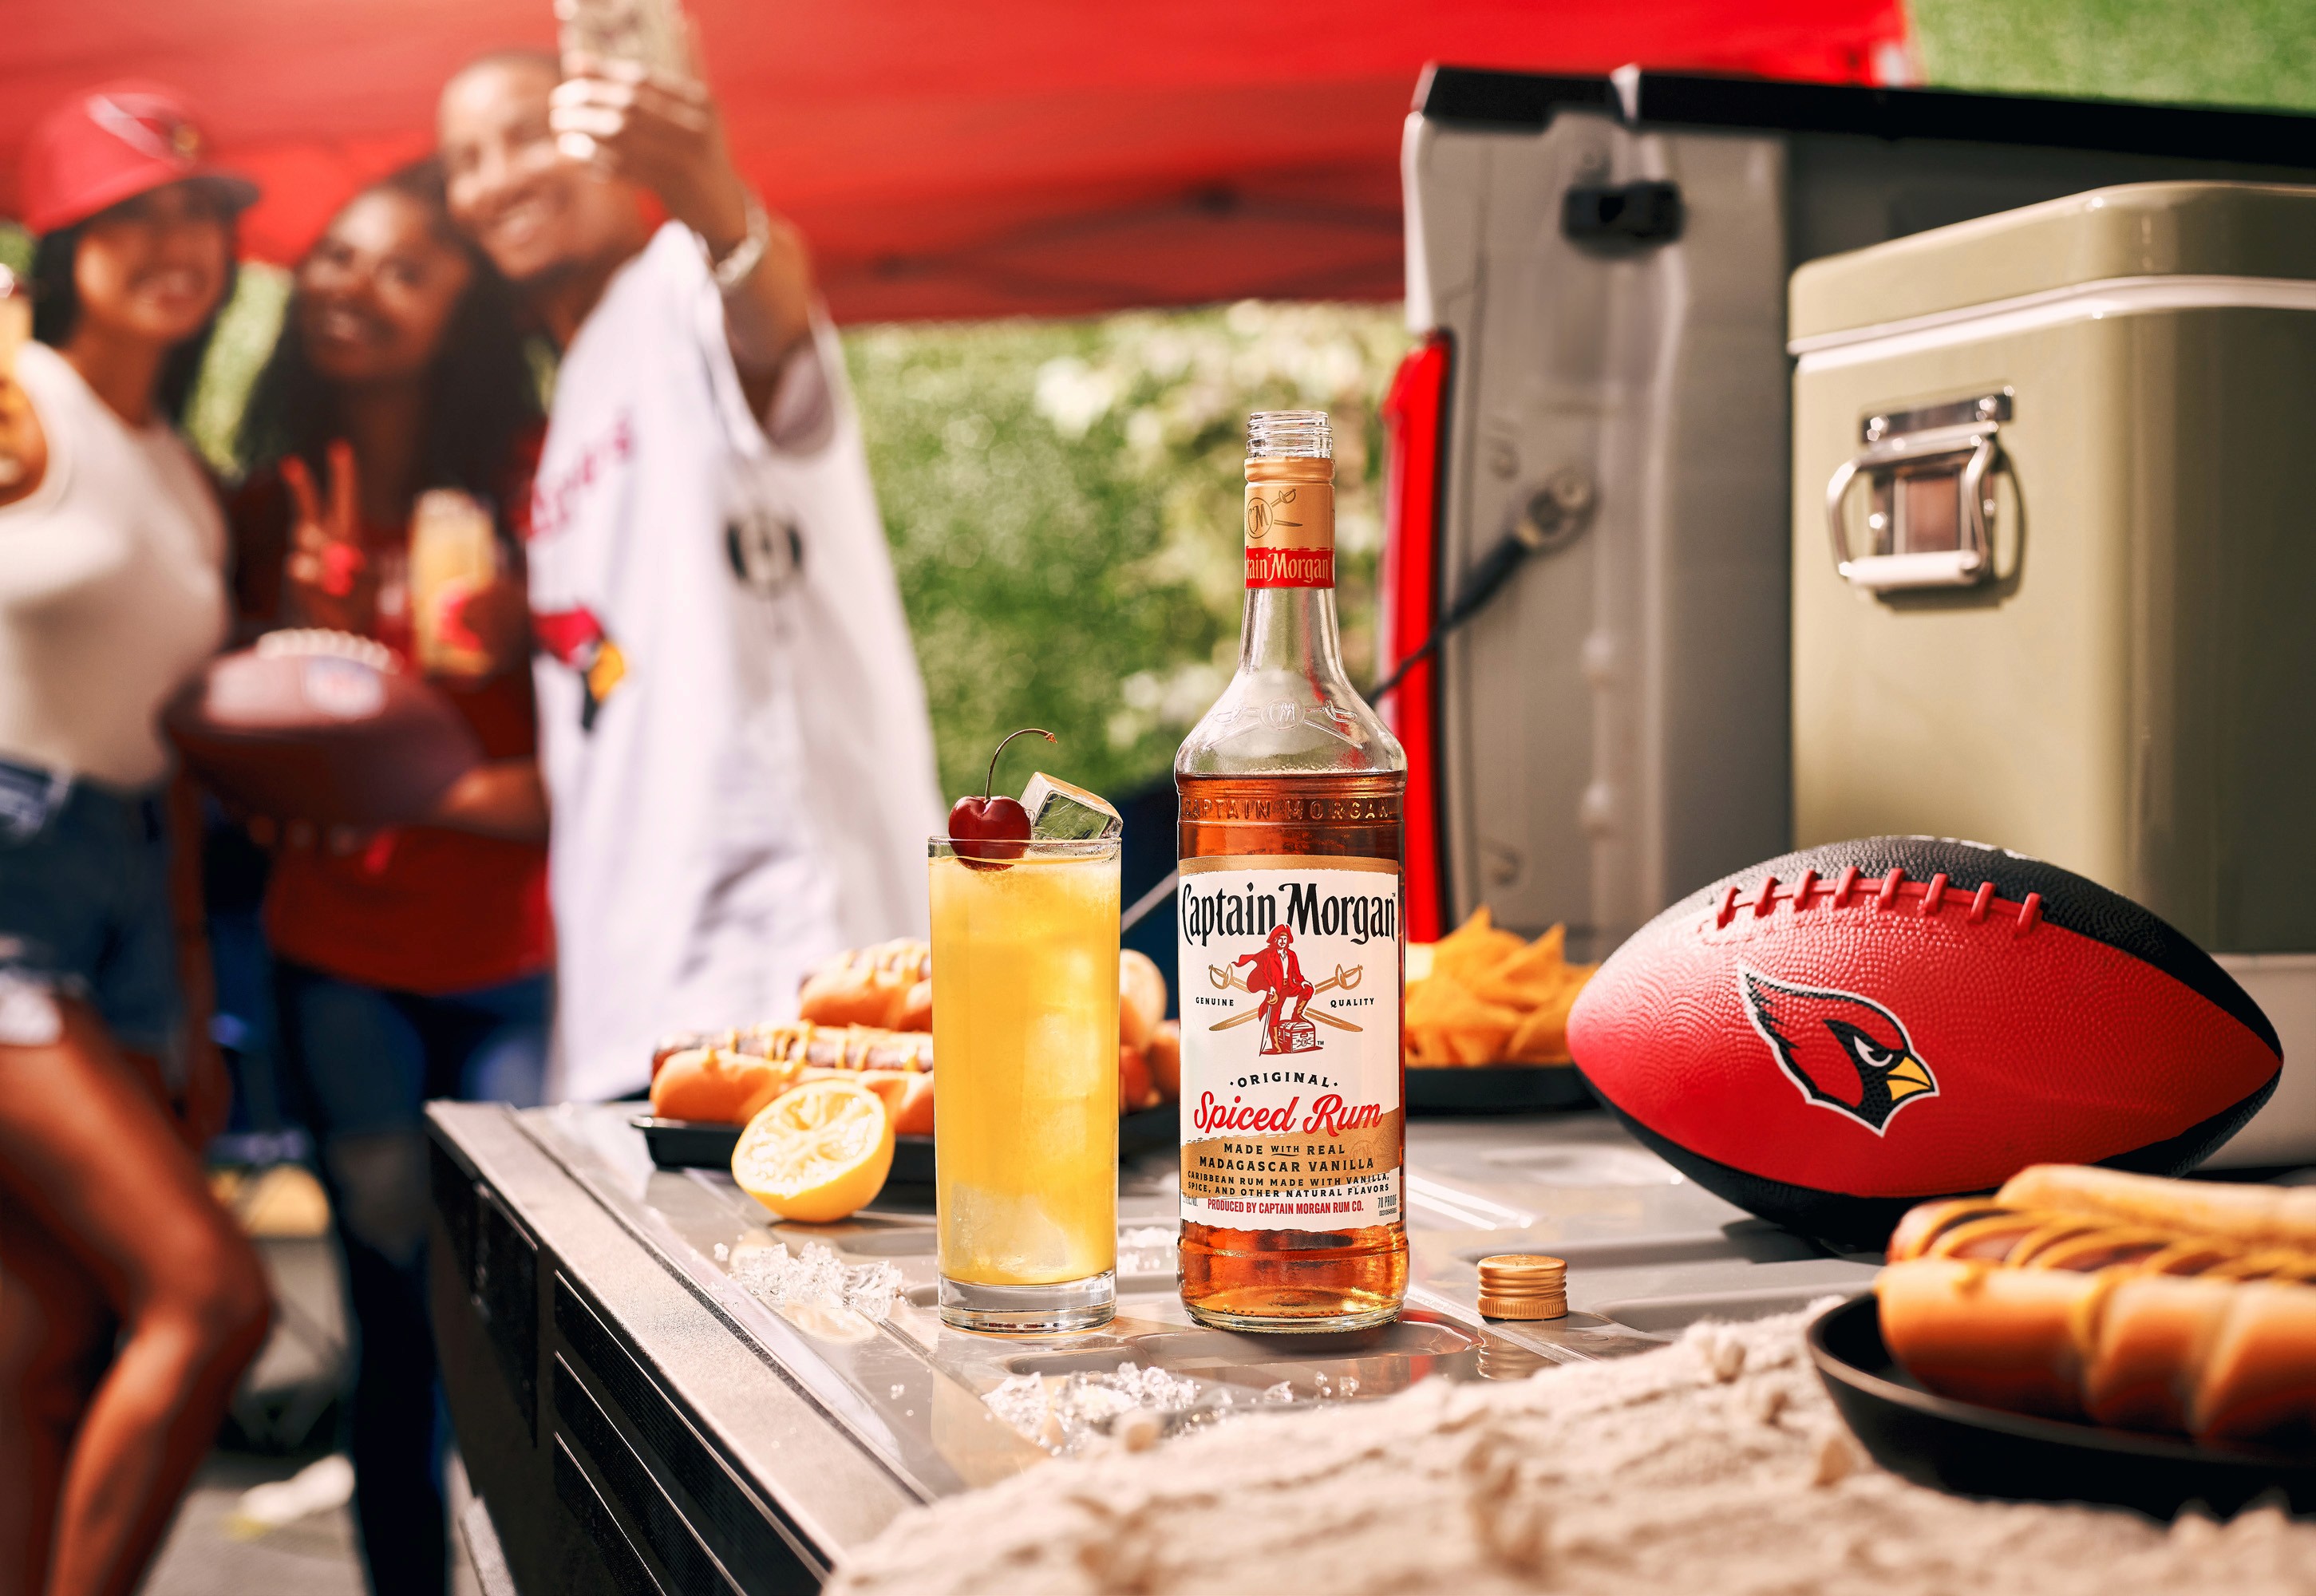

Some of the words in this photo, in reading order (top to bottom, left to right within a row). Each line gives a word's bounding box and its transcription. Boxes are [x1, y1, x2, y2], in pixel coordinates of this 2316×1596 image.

[1245, 553, 1267, 579] tain
[1267, 553, 1328, 583] Morgan
[1184, 799, 1271, 820] CAPTAIN
[1286, 799, 1389, 820] MORGAN
[1182, 882, 1275, 947] Captain
[1278, 883, 1395, 945] Morgan
[1196, 997, 1234, 1006] GENUINE
[1330, 998, 1374, 1008] QUALITY
[1194, 1091, 1300, 1133] Spiced
[1302, 1094, 1384, 1137] Rum
[1223, 1143, 1263, 1155] MADE
[1307, 1144, 1345, 1155] REAL
[1199, 1156, 1300, 1172] MADAGASCAR
[1308, 1158, 1373, 1172] VANILLA
[1188, 1171, 1235, 1184] CARIBBEAN
[1346, 1173, 1389, 1185] VANILLA,
[1188, 1181, 1211, 1194] SPICE,
[1215, 1187, 1235, 1195] AND
[1240, 1189, 1279, 1198] OTHER
[1286, 1189, 1342, 1198] NATURAL
[1347, 1183, 1389, 1195] FLAVORS
[1207, 1198, 1244, 1213] PRODUCED
[1246, 1202, 1257, 1213] BY
[1259, 1203, 1294, 1215] CAPTAIN
[1296, 1202, 1331, 1215] MORGAN
[1333, 1201, 1350, 1213] RUM
[1352, 1199, 1364, 1212] CO.
